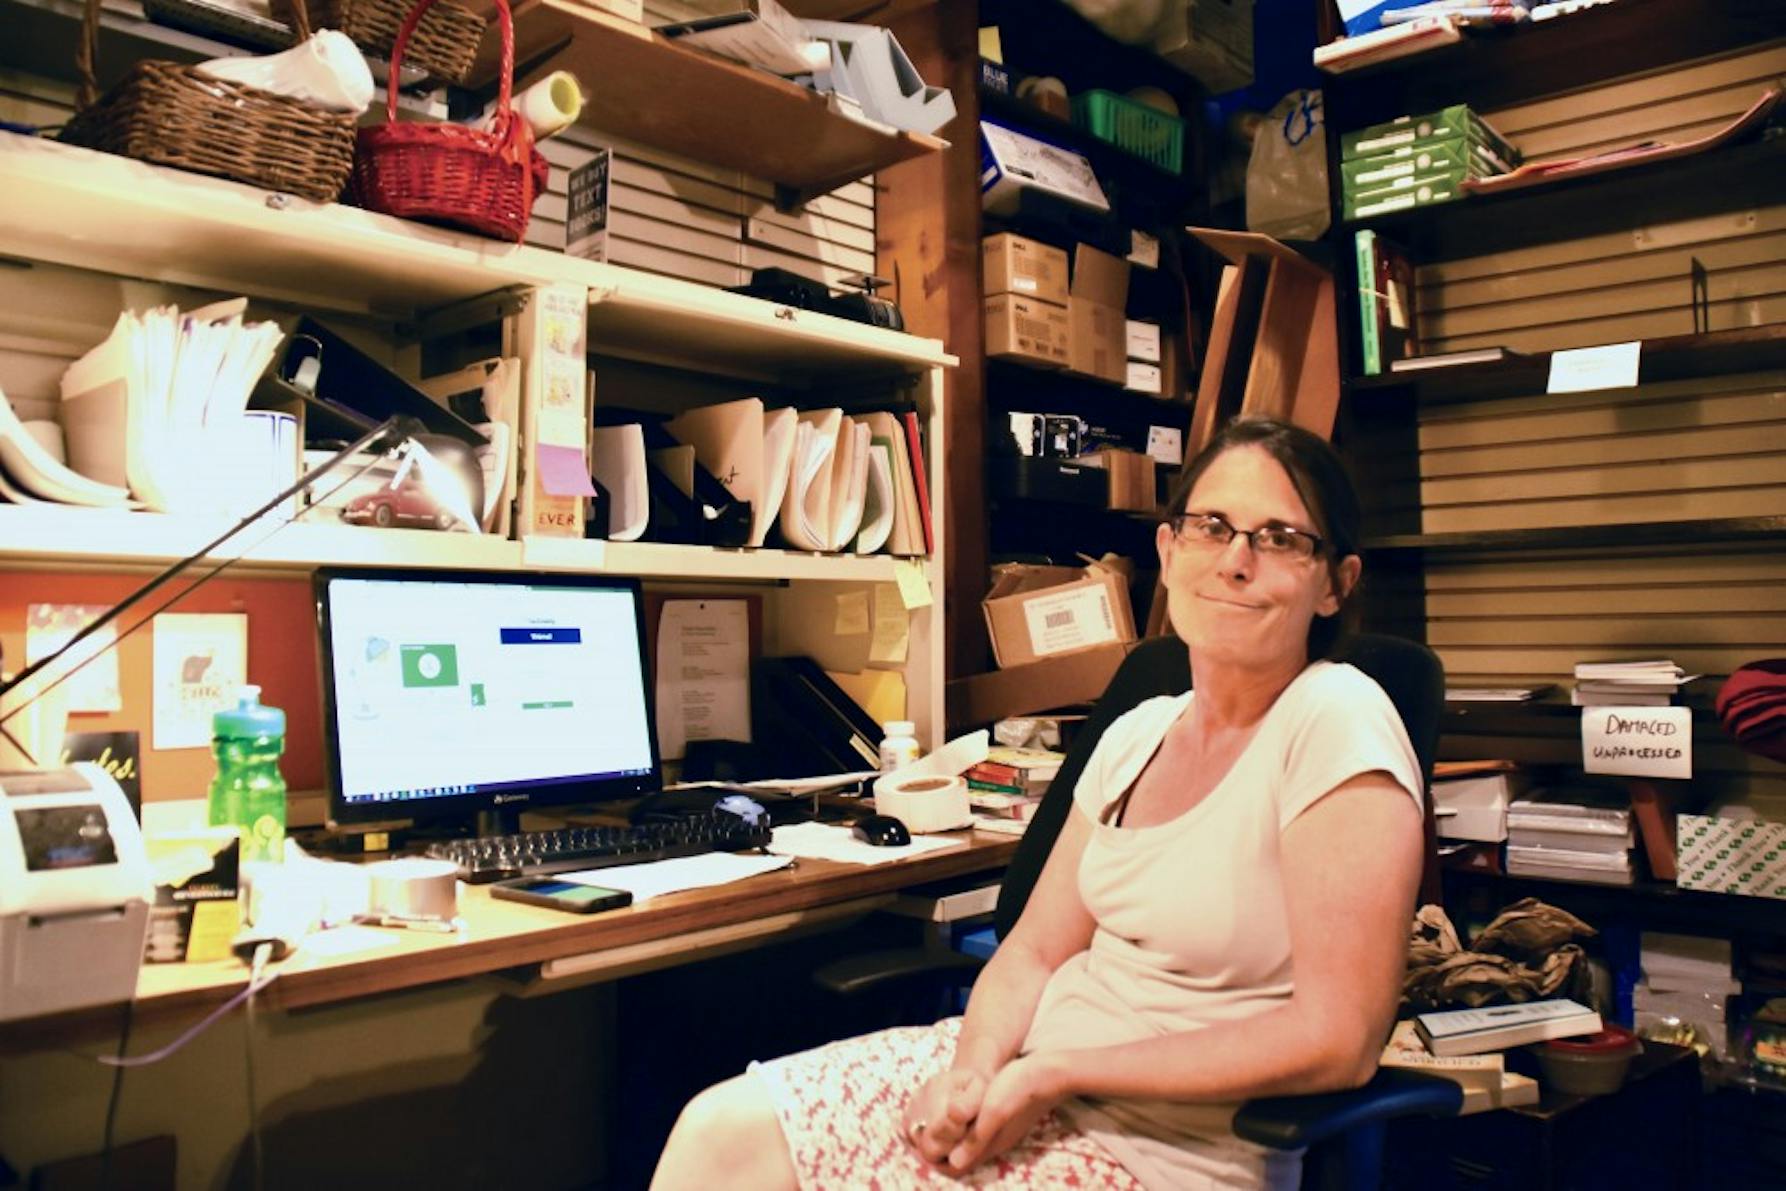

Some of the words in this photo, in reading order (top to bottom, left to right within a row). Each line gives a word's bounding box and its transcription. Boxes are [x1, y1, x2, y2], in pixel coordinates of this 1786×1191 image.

[574, 184, 602, 211] TEXT
[538, 511, 575, 526] EVER
[1605, 714, 1677, 736] DAMAGED
[1593, 745, 1682, 760] UNPROCESSED
[1727, 851, 1752, 873] Thank
